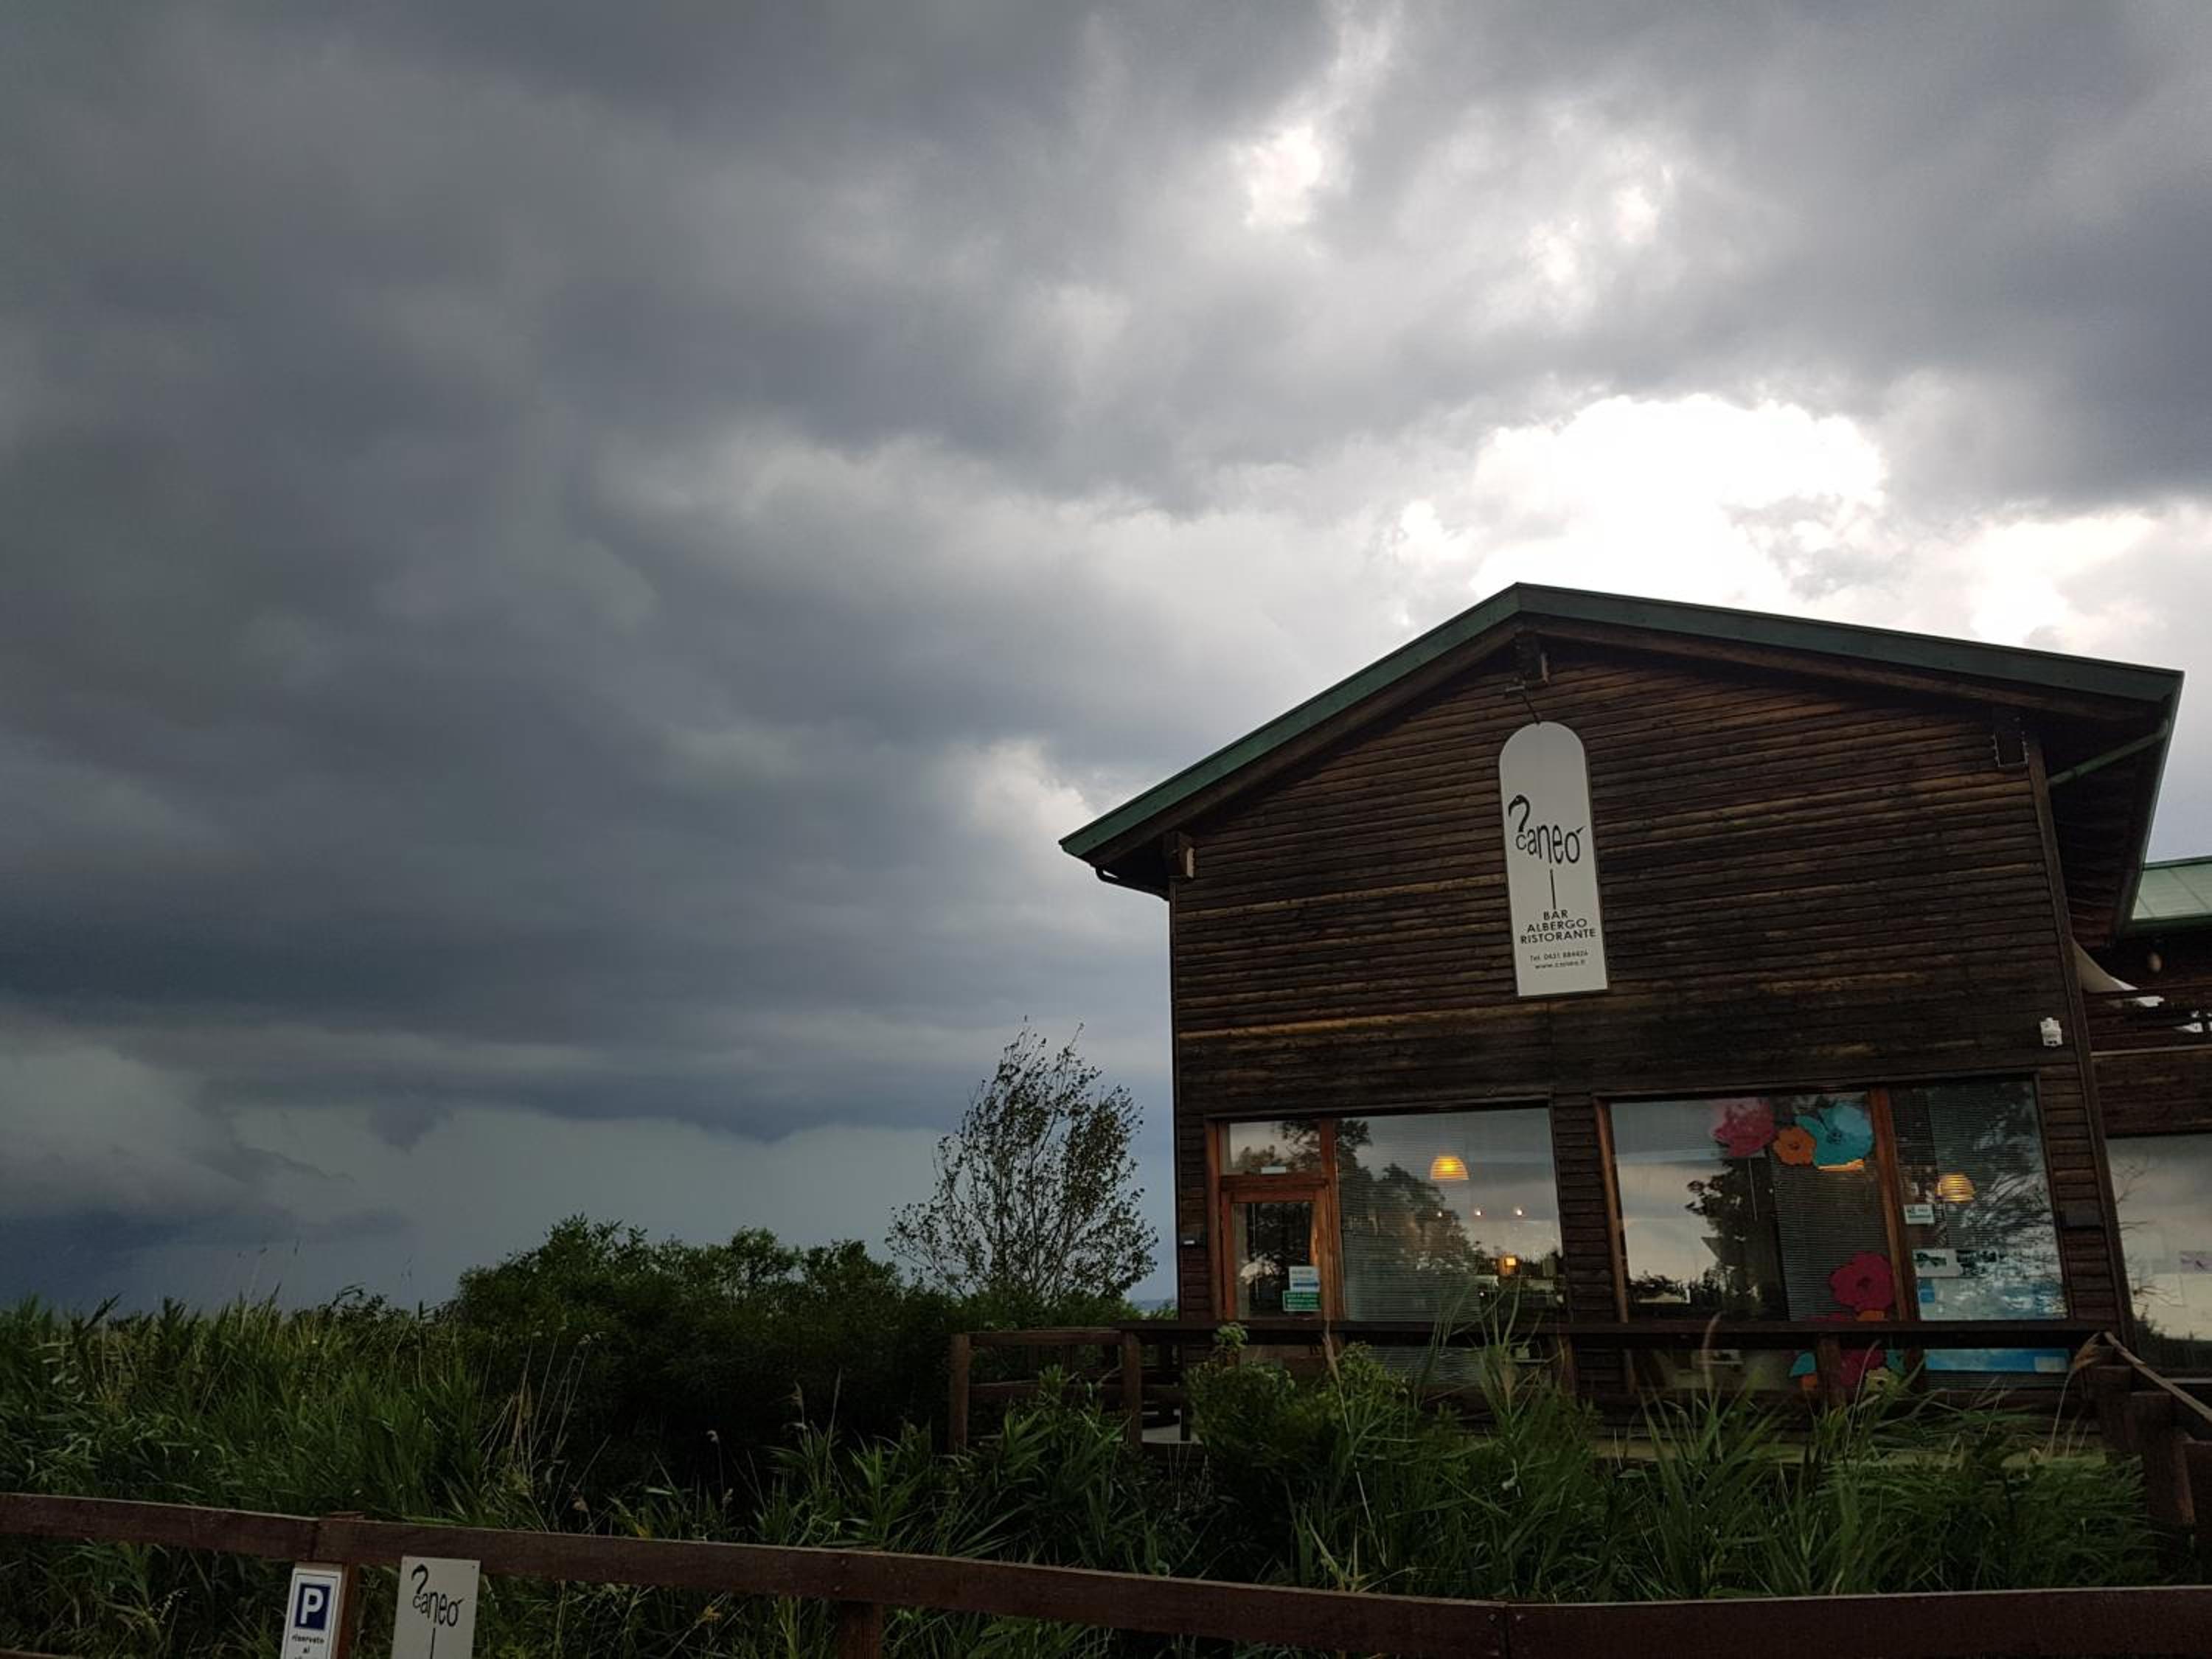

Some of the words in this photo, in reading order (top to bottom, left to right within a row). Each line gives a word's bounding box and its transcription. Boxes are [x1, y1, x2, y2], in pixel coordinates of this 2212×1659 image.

[1543, 909, 1568, 921] BAR
[1526, 918, 1587, 933] ALBERGO
[1520, 928, 1597, 945] RISTORANTE
[300, 1587, 324, 1625] P
[291, 1634, 325, 1645] riservato
[302, 1645, 310, 1654] al
